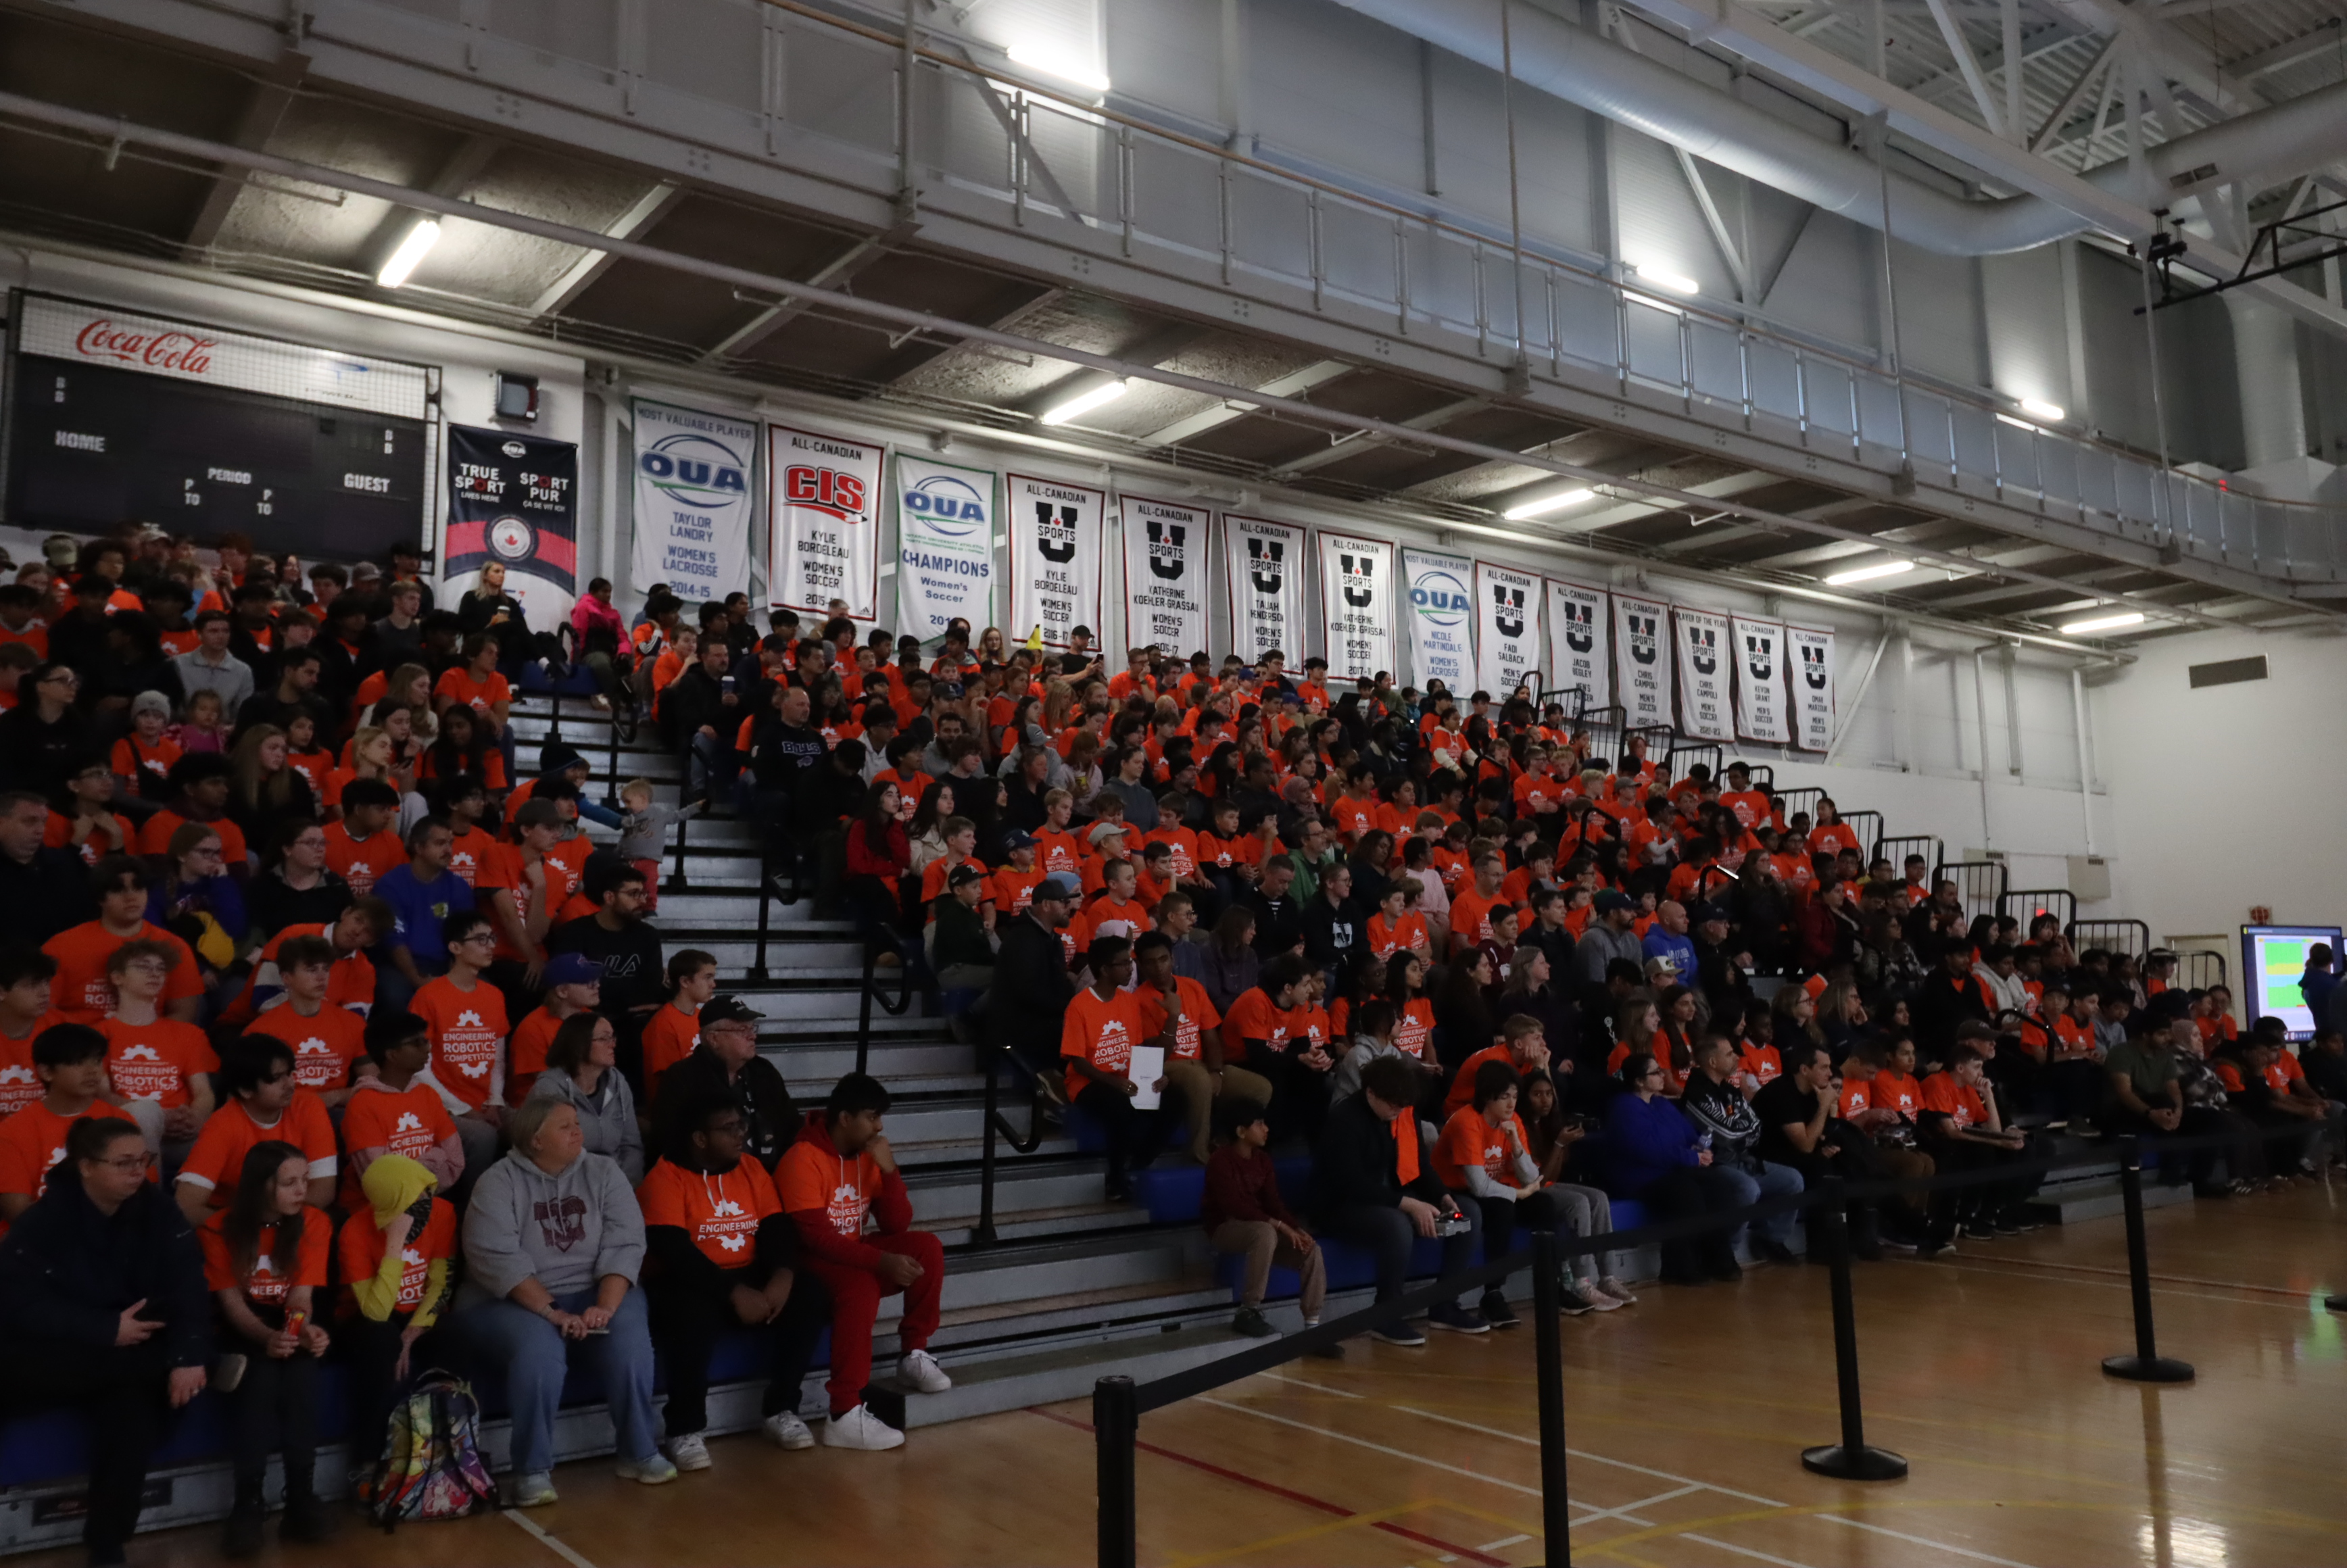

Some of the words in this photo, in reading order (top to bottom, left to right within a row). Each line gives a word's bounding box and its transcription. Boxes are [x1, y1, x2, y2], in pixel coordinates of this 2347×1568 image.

[76, 320, 218, 373] Coca-Cola
[637, 408, 662, 421] MOST
[667, 414, 713, 432] VALUABLE
[717, 424, 751, 439] PLAYER
[55, 430, 105, 452] HOME
[792, 437, 862, 460] ALL-CANADIAN
[208, 468, 251, 485] PERIOD
[460, 463, 500, 481] TRUE
[640, 452, 746, 491] OUA
[185, 479, 194, 491] P
[344, 473, 390, 493] GUEST
[455, 476, 506, 494] SPORT
[520, 472, 569, 491] SPORT
[263, 489, 272, 501] P
[530, 487, 560, 502] PUR
[785, 465, 865, 514] CIS
[1027, 484, 1086, 504] ALL-CANADIAN
[185, 493, 200, 506] TO
[481, 493, 500, 503] HERE
[257, 503, 272, 515] TO
[904, 491, 985, 523] OUA
[1138, 505, 1192, 522] ALL-CANADIAN
[673, 512, 711, 529] TAYLOR
[670, 525, 712, 542] LANDRY
[812, 530, 836, 544] KYLIE
[1038, 525, 1075, 541] SPORTS
[1240, 522, 1290, 539] ALL-CANADIAN
[798, 541, 849, 559] BORDELEAU
[1149, 543, 1183, 559] SPORTS
[1333, 539, 1379, 554] ALL-CANADIAN
[668, 545, 716, 563] WOMEN'S
[663, 559, 718, 578] LACROSSE
[803, 560, 843, 577] WOMEN'S
[902, 549, 989, 577] CHAMPIONS
[1251, 560, 1282, 573] SPORTS
[1404, 554, 1419, 564] MOST
[1421, 557, 1447, 568] VALUABLE
[1449, 561, 1468, 572] PLAYER
[806, 574, 839, 589] SOCCER
[1046, 570, 1067, 582] KYLIE
[1342, 575, 1372, 589] SPORTS
[1488, 570, 1530, 587] ALL-CANADIAN
[669, 581, 710, 597] 2014-15
[921, 577, 967, 591] Women's
[1034, 580, 1078, 595] BORDELEAU
[925, 590, 963, 603] Soccer
[1149, 585, 1185, 599] KATHERINE
[1557, 587, 1597, 603] ALL-CANADIAN
[1040, 597, 1071, 612] WOMEN'S
[1134, 595, 1199, 612] KOEHLER-GRASSAU
[1410, 588, 1470, 611] OUA
[1495, 605, 1523, 620] SPORTS
[1622, 601, 1660, 615] ALL-CANADIAN
[929, 614, 950, 625] 201
[1043, 610, 1069, 622] SOCCER
[1152, 614, 1182, 626] WOMEN'S
[1251, 609, 1284, 622] HENDERSON
[1343, 614, 1373, 625] KATHERINE
[1676, 612, 1695, 622] PLAYER
[1703, 617, 1712, 625] THE
[1044, 628, 1069, 641] 2016-17
[1153, 625, 1179, 637] SOCCER
[1255, 627, 1282, 637] WOMEN'S
[1330, 622, 1386, 637] KOEHLER-GRASSAU
[1566, 621, 1592, 635] SPORTS
[1741, 623, 1774, 635] ALL-CANADIAN
[1256, 637, 1280, 648] SOCCER
[1431, 631, 1451, 641] NICOLE
[1630, 634, 1655, 647] SPORTS
[1795, 633, 1827, 644] ALL-CANADIAN
[1424, 639, 1462, 652] MARTINDALE
[1504, 643, 1517, 653] FADI
[1692, 645, 1715, 658] SPORTS
[1347, 650, 1370, 660] SOCCER
[1429, 656, 1457, 666] WOMEN'S
[1498, 652, 1524, 664] SALBACK
[1749, 654, 1770, 664] SPORTS
[1572, 658, 1590, 669] JACOB
[1805, 662, 1825, 673] SPORTS
[1427, 666, 1459, 677] LACROSSE
[1503, 668, 1520, 679] MEN'S
[1638, 670, 1653, 680] CHRIS
[1699, 680, 1714, 689] CHRIS
[1754, 685, 1770, 694] KEVON
[1574, 690, 1593, 702] SOCER
[1639, 693, 1655, 703] MEN'S
[1697, 689, 1718, 699] CAMPOLI
[1755, 693, 1770, 703] GRANT
[1701, 703, 1716, 712] MEN'S
[1699, 711, 1718, 721] SOCCER
[1755, 714, 1772, 724] SOCCER
[781, 741, 821, 756] BILLS
[589, 952, 641, 978] ILA
[1394, 1034, 1425, 1046] ROBOTIC
[110, 1065, 178, 1075] NGINEERING
[114, 1073, 178, 1086] OBOTICS
[699, 1219, 758, 1233] ENGINEERING
